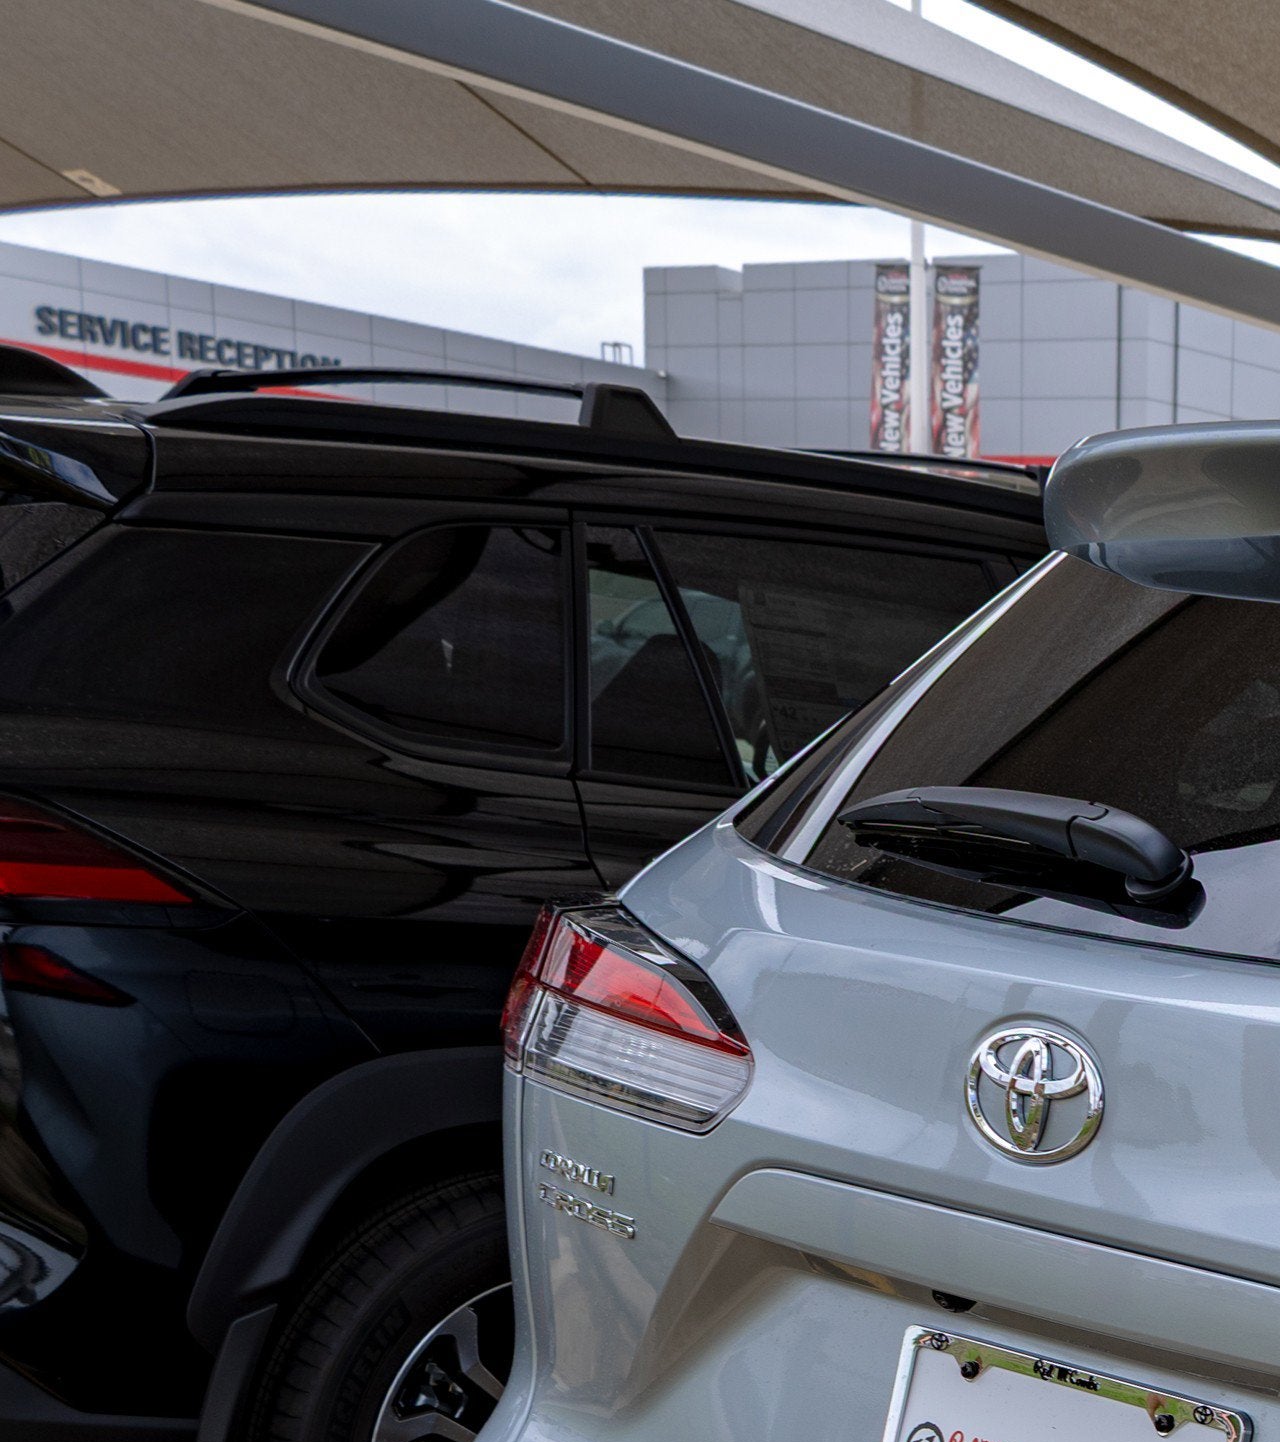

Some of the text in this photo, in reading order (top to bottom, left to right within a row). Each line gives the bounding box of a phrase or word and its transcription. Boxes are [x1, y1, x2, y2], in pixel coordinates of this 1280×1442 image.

[35, 304, 171, 355] SERVICE
[880, 311, 903, 406] Vehicles
[940, 313, 964, 410] Vehicles
